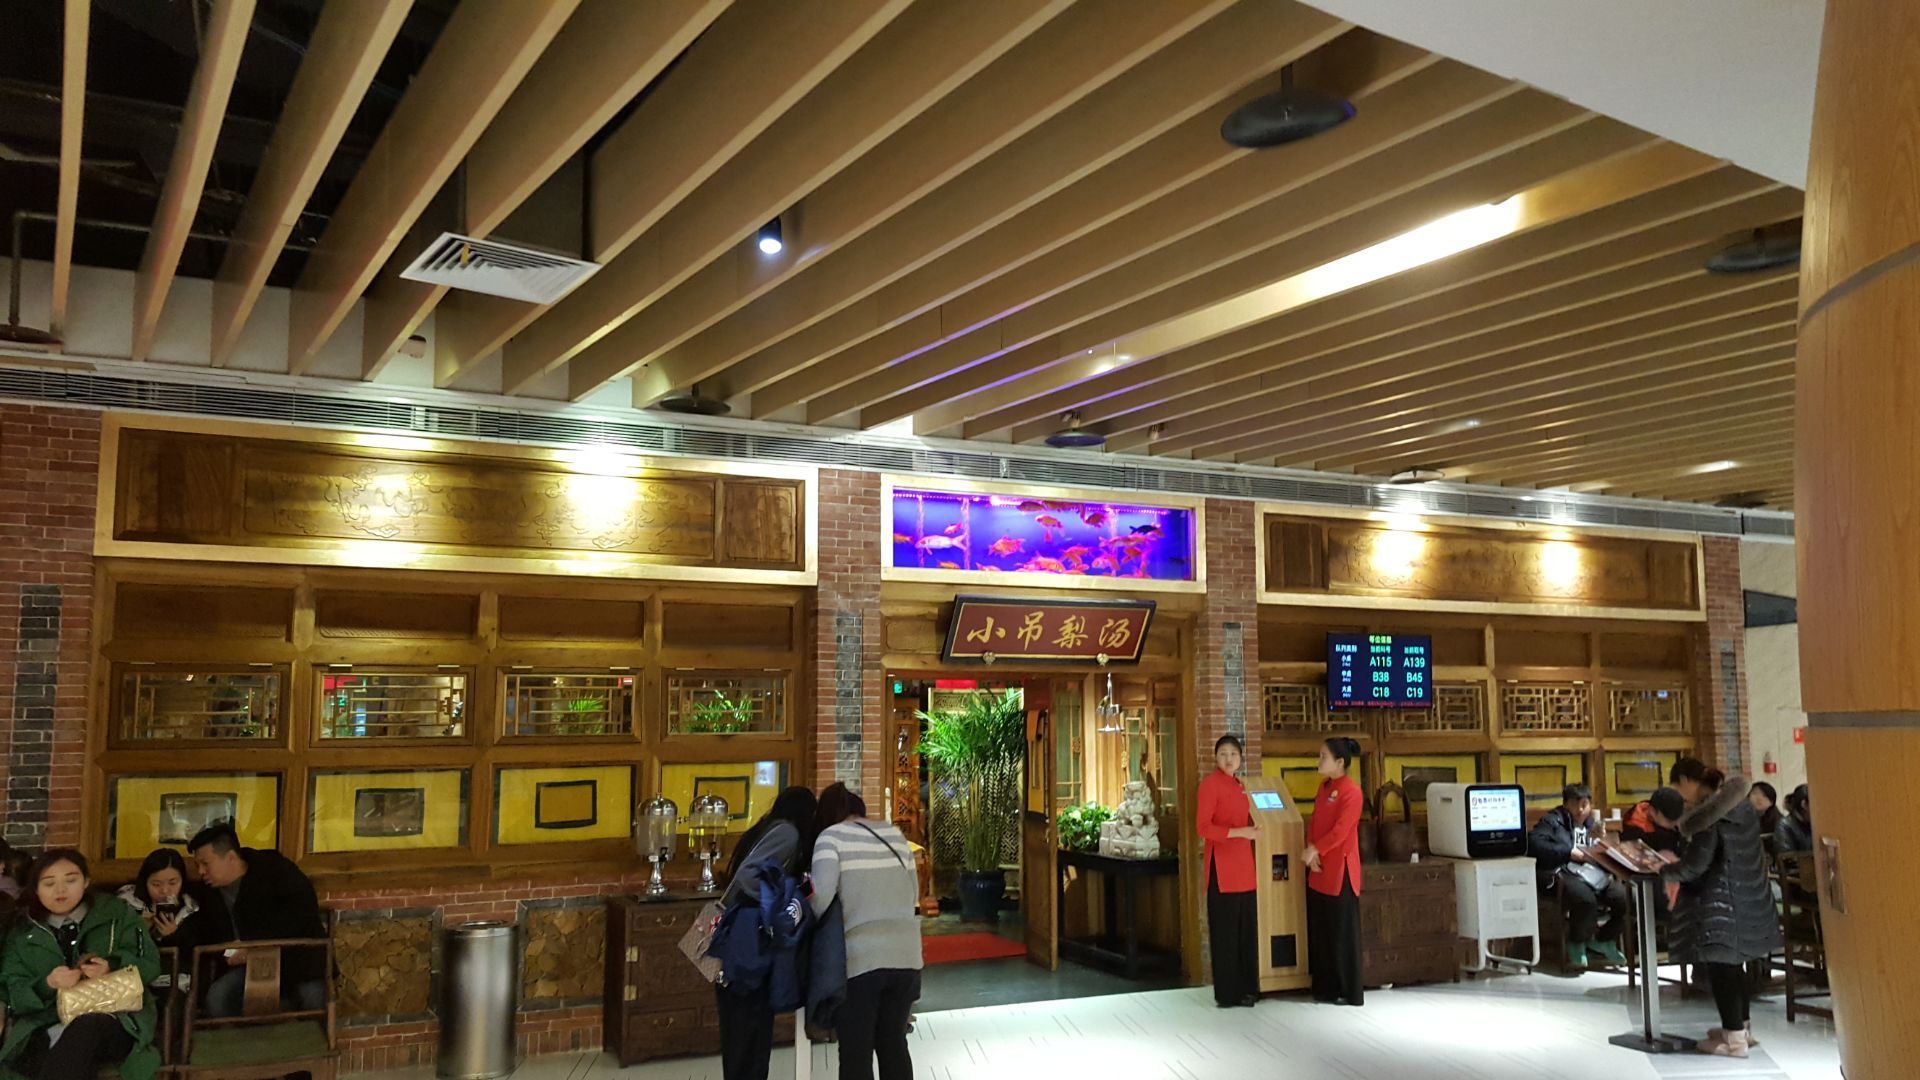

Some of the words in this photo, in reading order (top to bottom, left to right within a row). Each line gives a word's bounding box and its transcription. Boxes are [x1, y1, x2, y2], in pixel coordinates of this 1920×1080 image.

[967, 610, 1131, 650] 小吊梨汤
[1369, 656, 1392, 667] A115
[1403, 657, 1425, 668] A139
[1372, 671, 1390, 682] B38
[1406, 672, 1423, 683] B45
[1372, 687, 1390, 698] C18
[1406, 687, 1423, 698] C19
